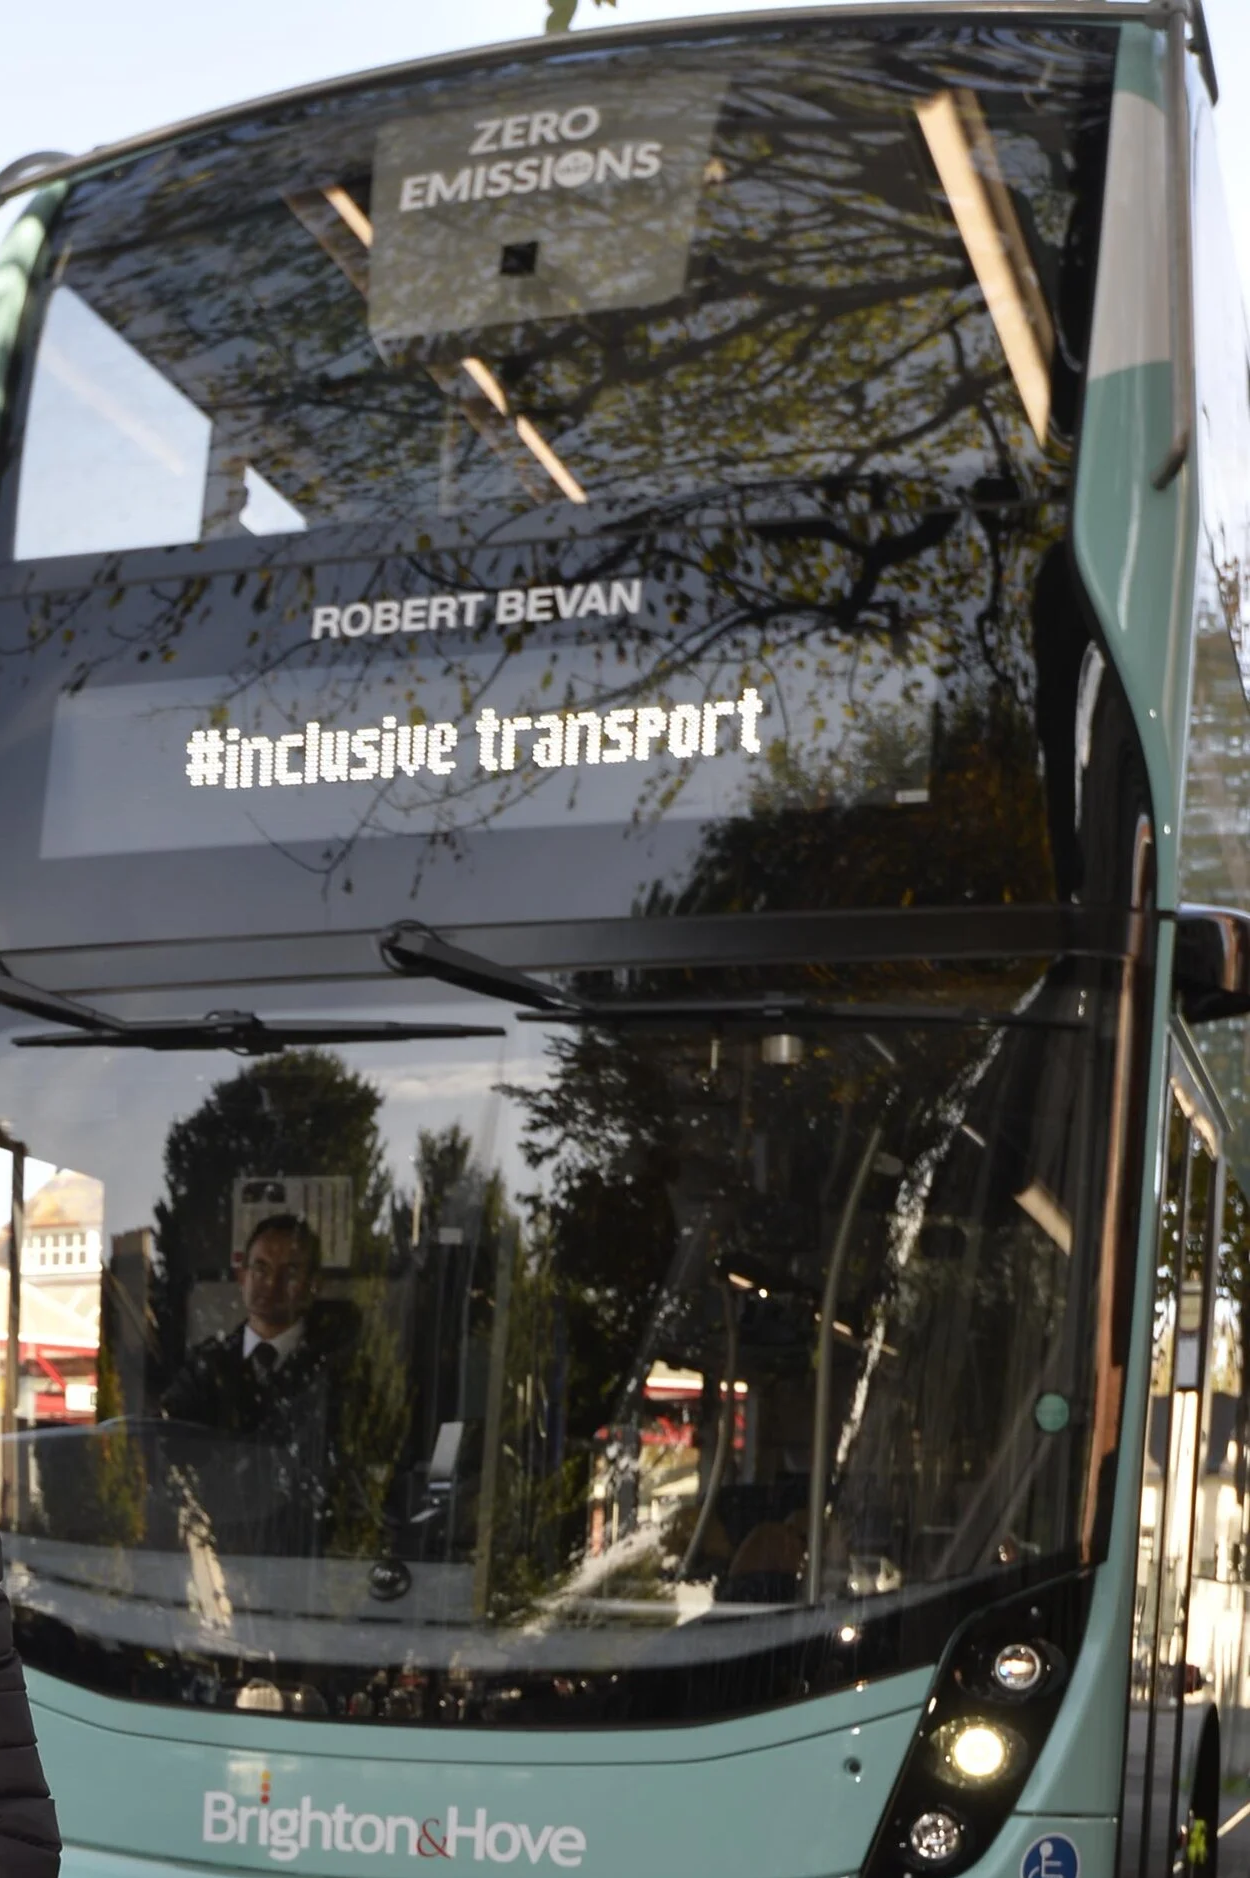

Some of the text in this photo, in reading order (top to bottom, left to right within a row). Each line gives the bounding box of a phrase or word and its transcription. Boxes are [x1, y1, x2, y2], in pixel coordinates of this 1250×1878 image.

[468, 105, 600, 156] ZERO
[398, 141, 663, 213] EMISSIONS
[310, 580, 643, 640] ROBERT BEVAN
[185, 687, 763, 790] #inclusive transport
